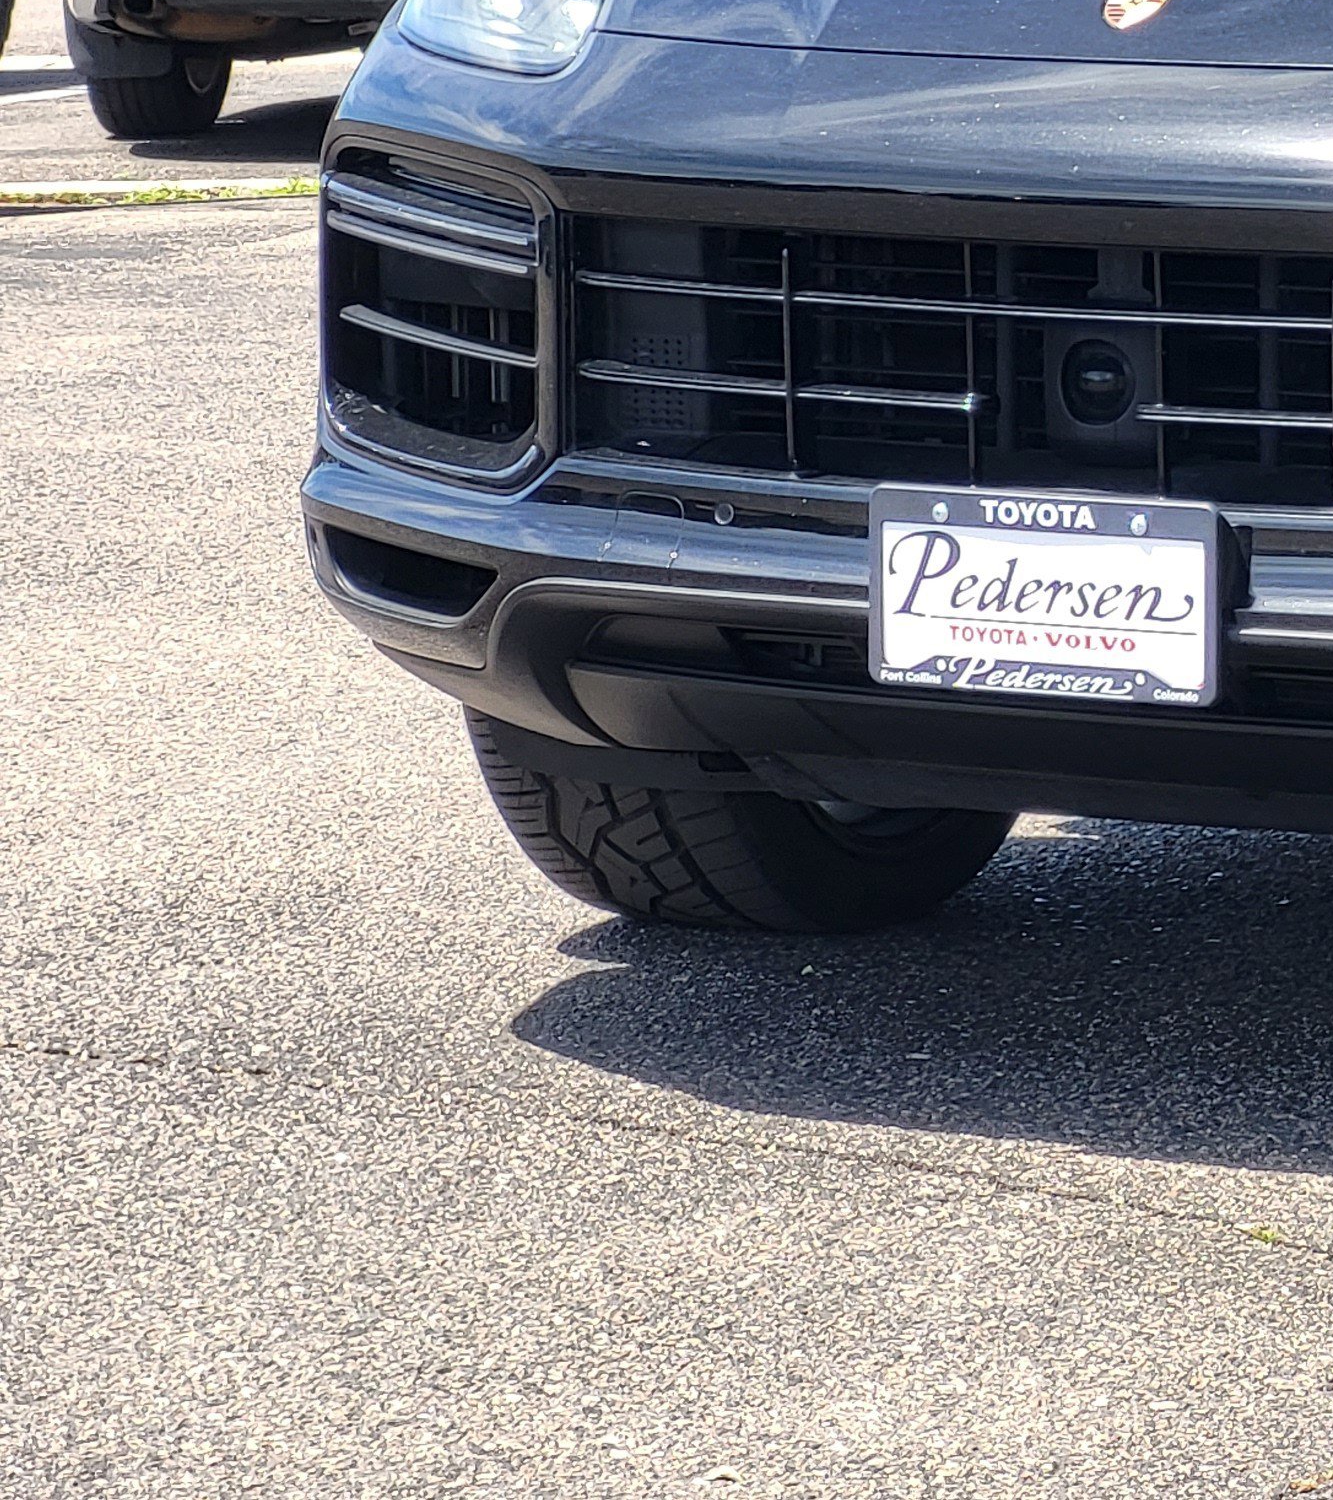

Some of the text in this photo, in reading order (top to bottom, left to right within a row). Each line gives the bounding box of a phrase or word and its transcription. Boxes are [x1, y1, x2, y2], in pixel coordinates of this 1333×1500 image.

[980, 499, 1096, 530] TOYOTA
[889, 531, 1194, 621] Pedersen
[949, 625, 1137, 652] TOYOTA VOLVO
[880, 655, 1199, 703] Fort Collins Pedersen Colorado
